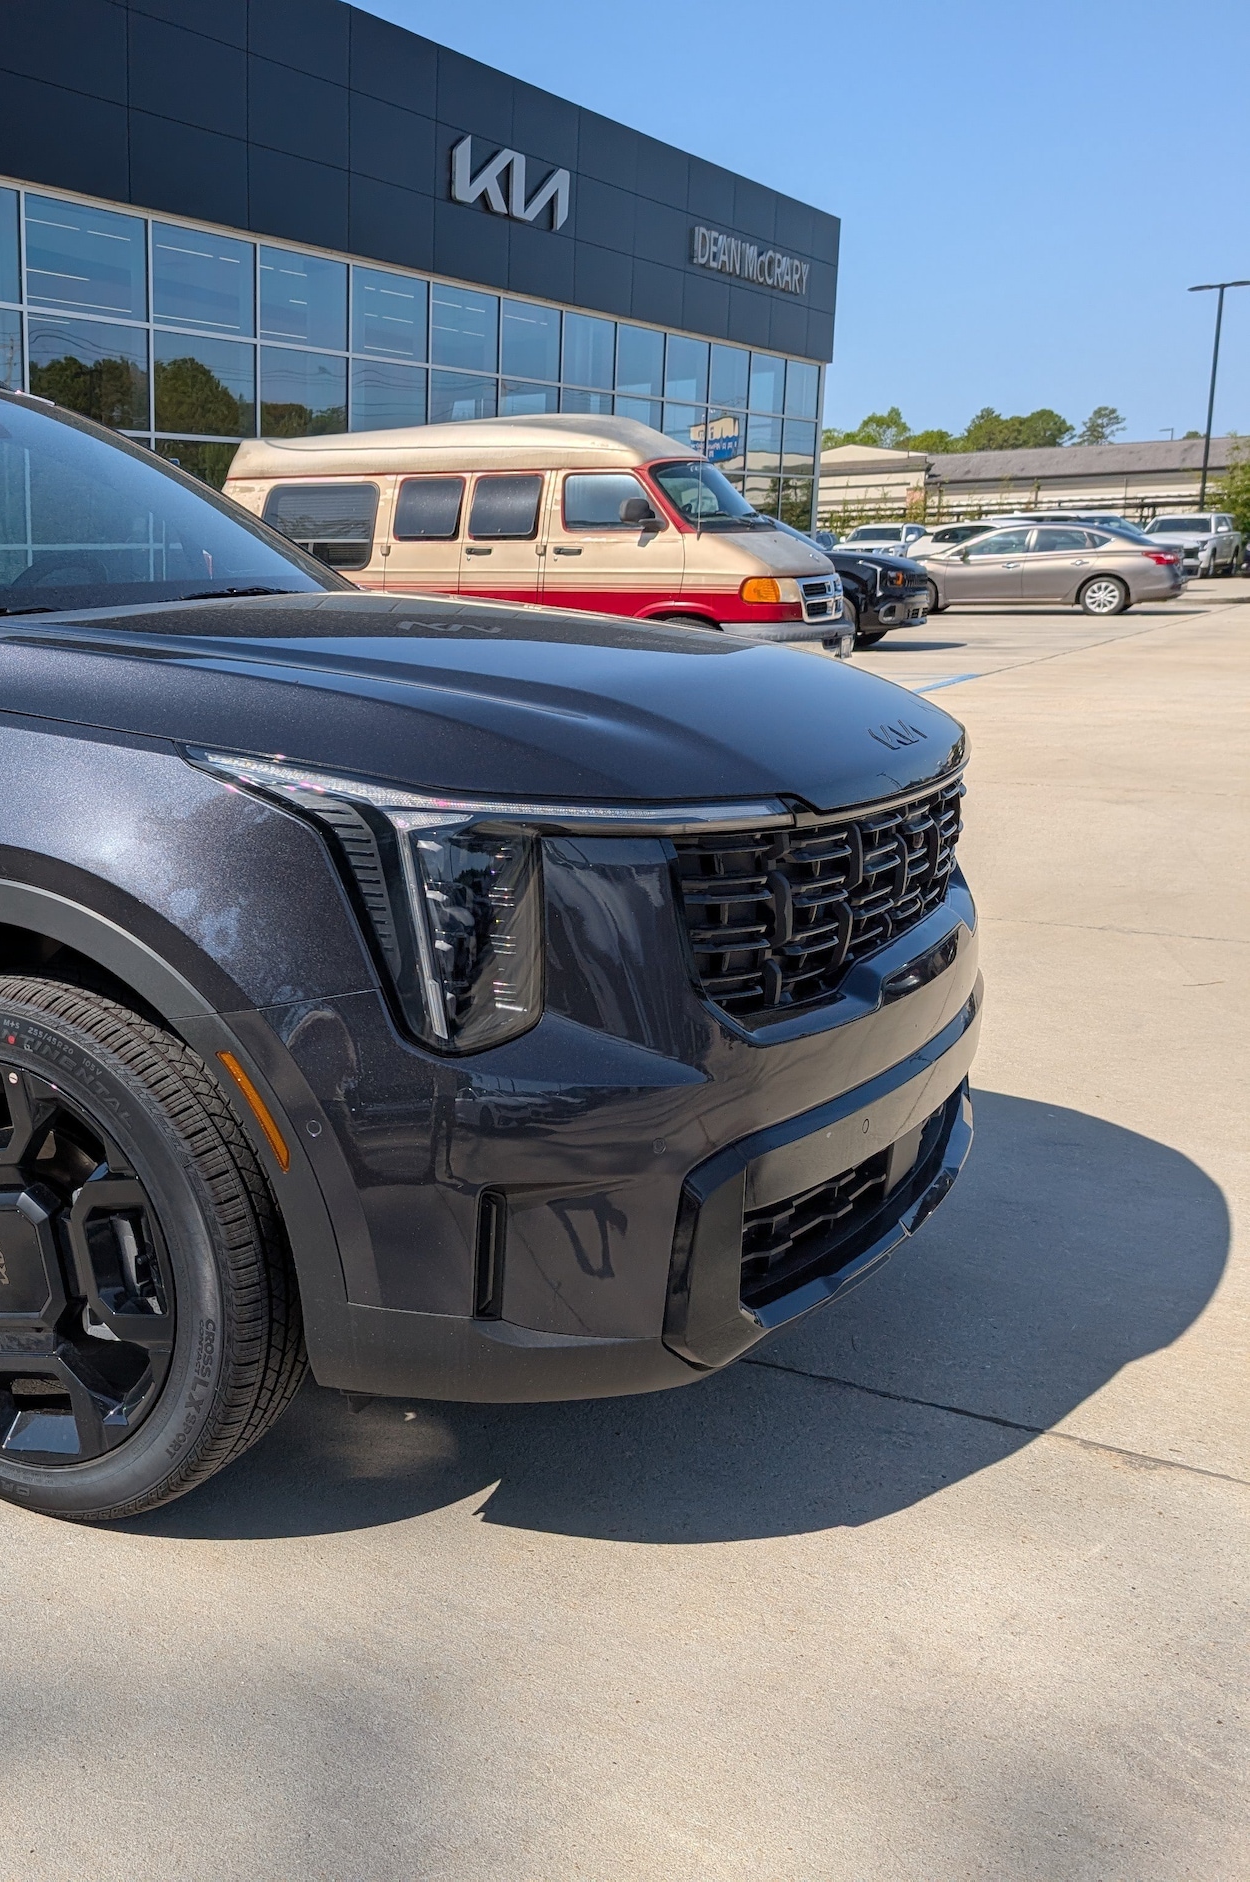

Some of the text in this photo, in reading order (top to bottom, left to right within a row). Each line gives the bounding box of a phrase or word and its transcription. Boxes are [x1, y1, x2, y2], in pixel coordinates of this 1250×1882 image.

[451, 134, 570, 231] KIA
[694, 226, 810, 295] DEAN McCRARY
[3, 1018, 102, 1076] M+S 255/45R20 105V
[194, 1320, 206, 1376] CONTACT
[201, 1318, 217, 1378] CROSS
[166, 1412, 197, 1460] SPORT
